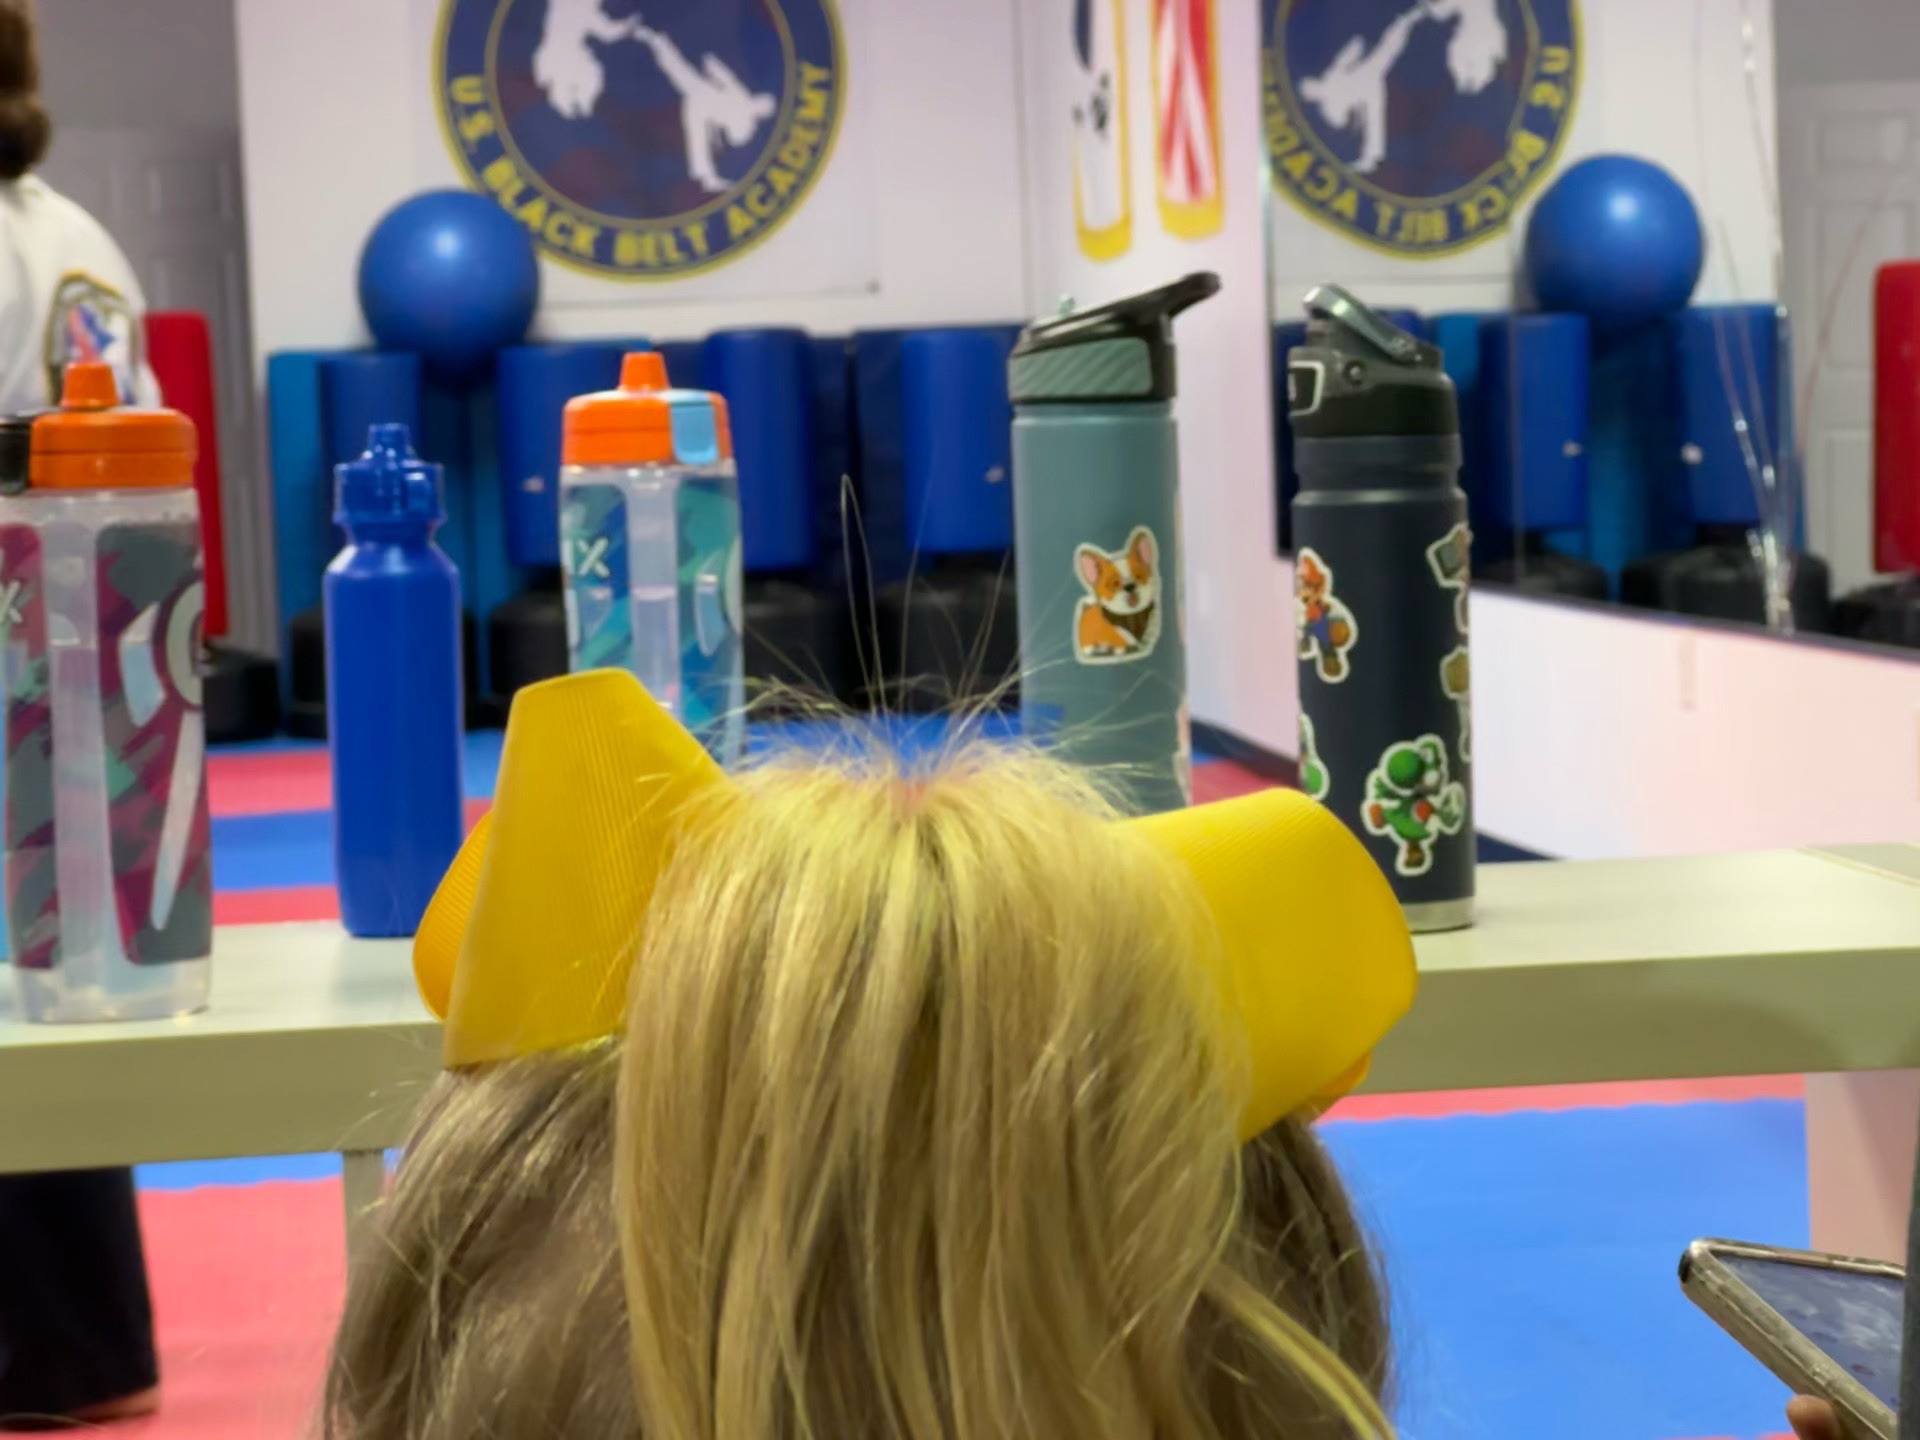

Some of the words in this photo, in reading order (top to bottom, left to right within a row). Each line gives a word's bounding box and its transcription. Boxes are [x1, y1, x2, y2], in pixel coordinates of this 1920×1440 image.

[482, 157, 599, 258] BLACK
[613, 223, 709, 267] BELT
[724, 61, 832, 241] ACADEMY
